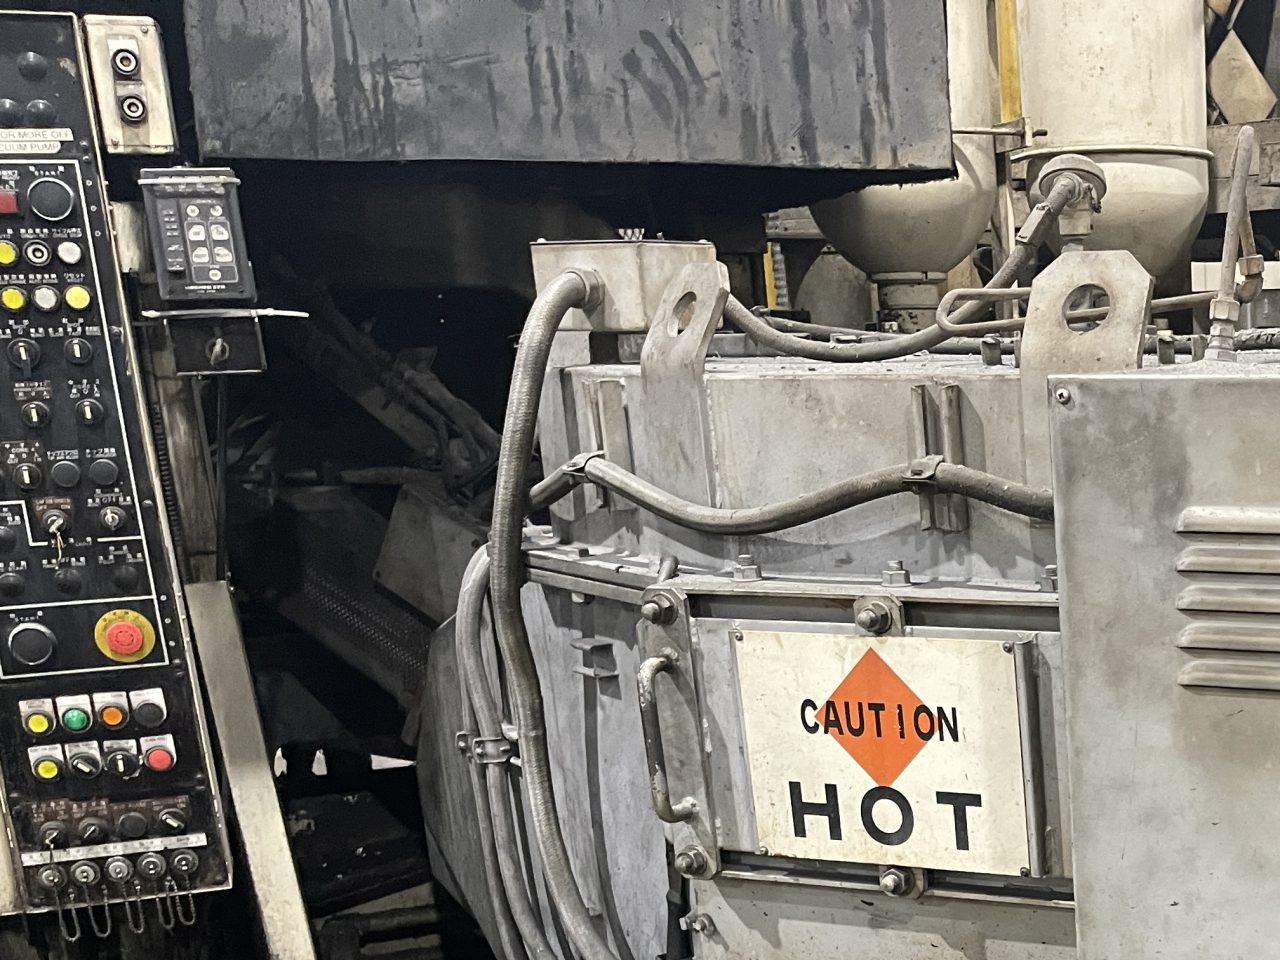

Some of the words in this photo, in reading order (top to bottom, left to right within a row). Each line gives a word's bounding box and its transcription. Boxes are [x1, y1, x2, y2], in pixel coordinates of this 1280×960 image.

[18, 130, 49, 139] MORE
[50, 130, 70, 139] OFF
[30, 142, 59, 152] PUMP
[800, 698, 959, 743] CAUTION
[788, 780, 983, 851] HOT
